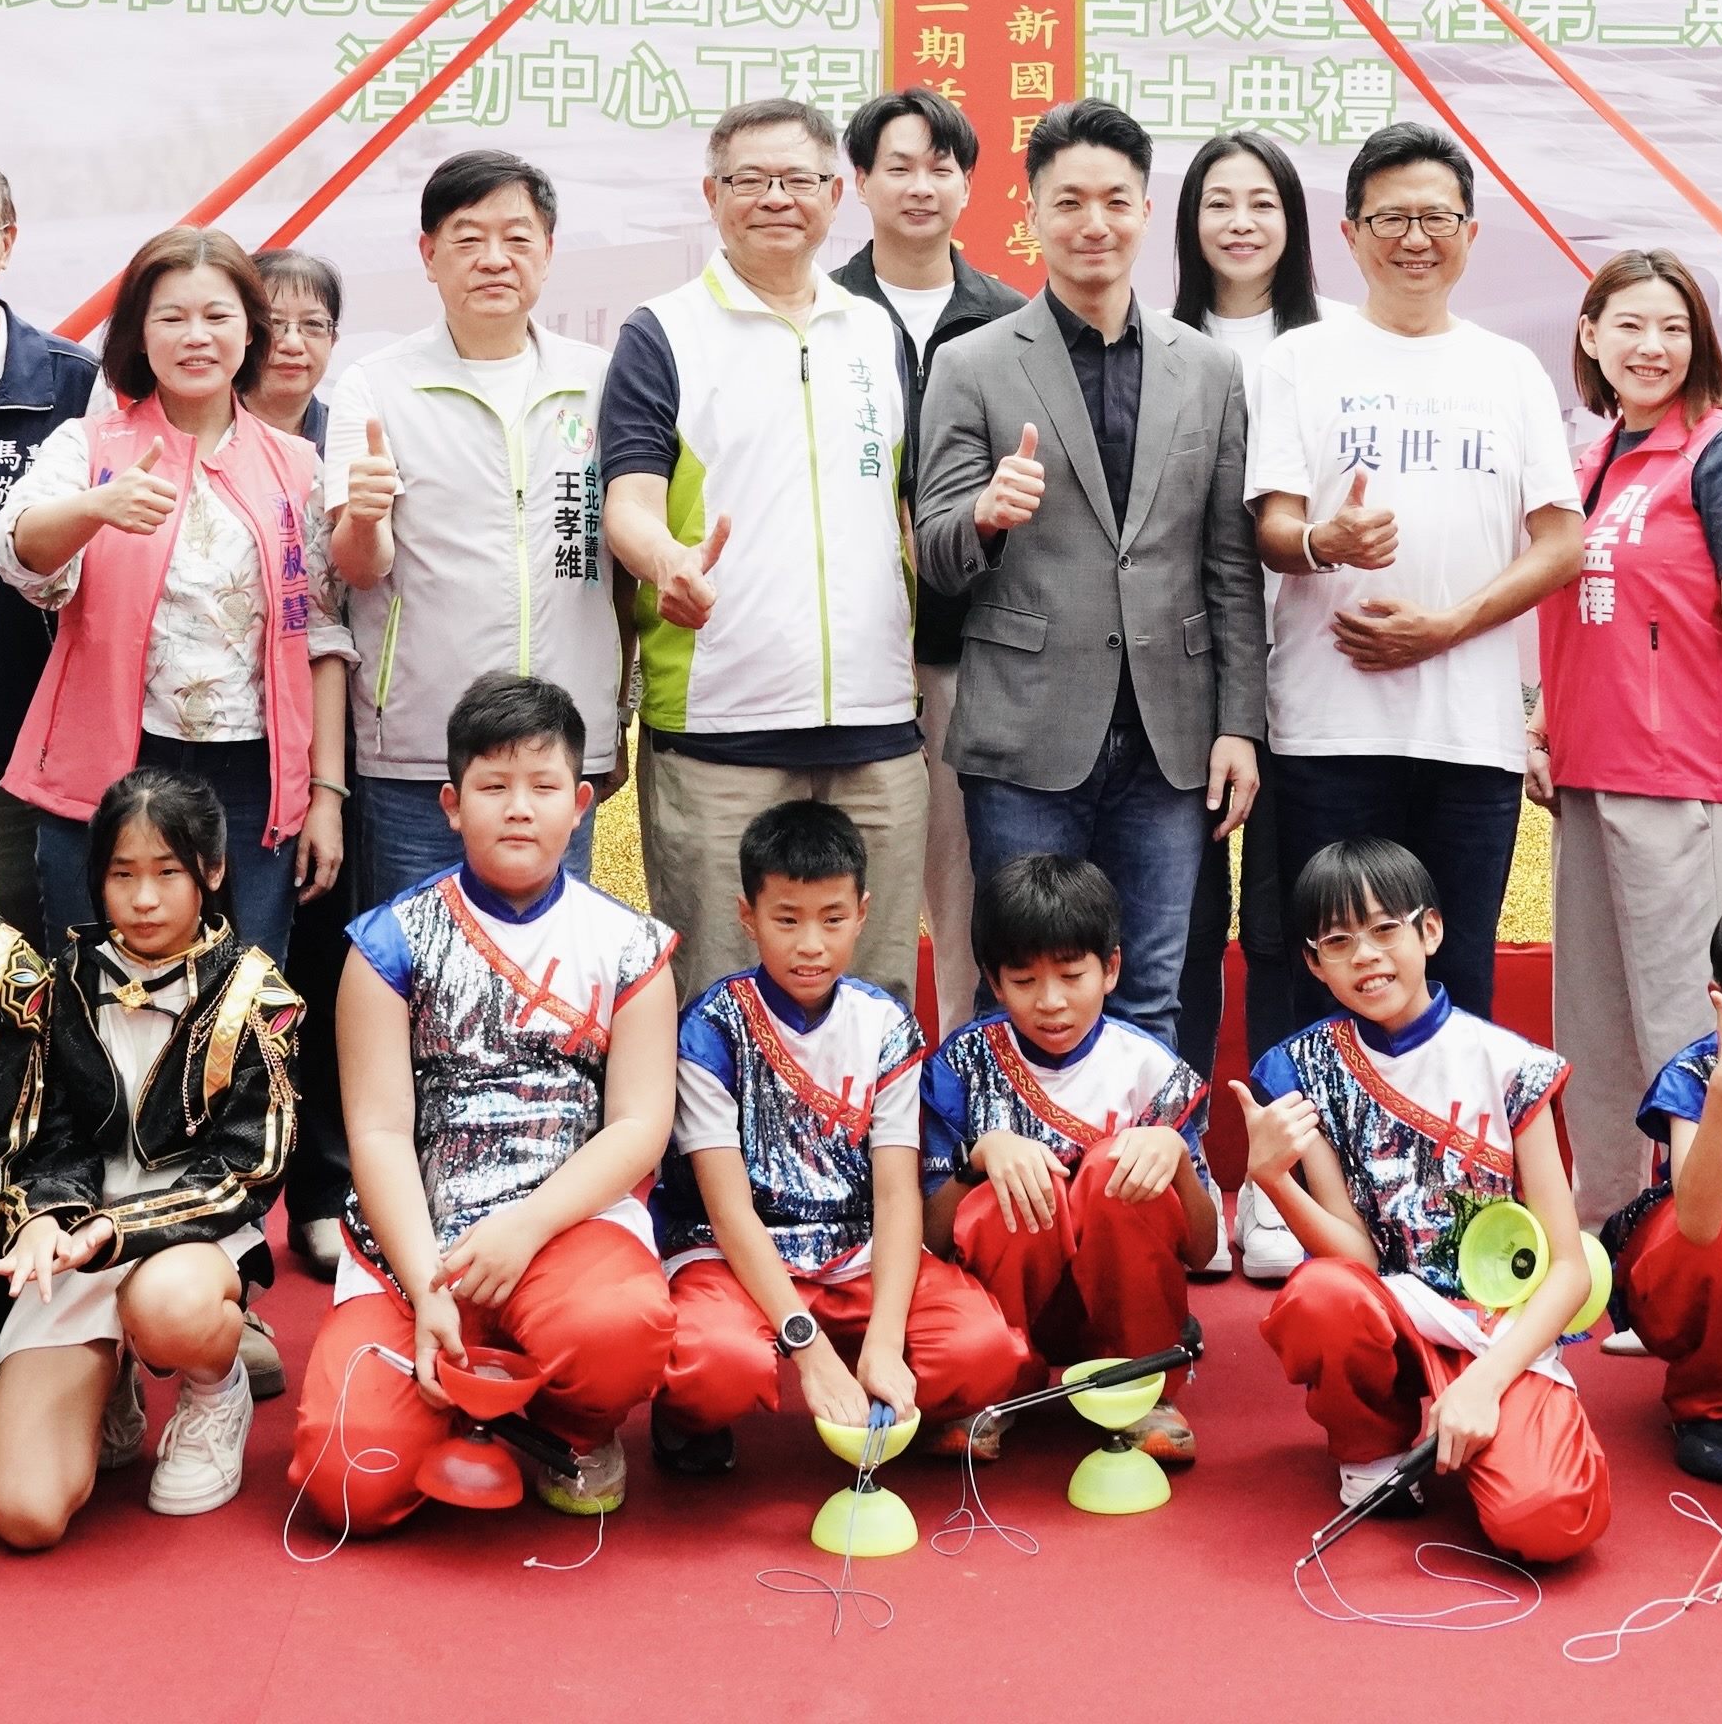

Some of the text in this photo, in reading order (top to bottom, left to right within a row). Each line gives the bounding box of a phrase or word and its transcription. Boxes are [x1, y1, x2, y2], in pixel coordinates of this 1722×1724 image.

[335, 36, 1397, 145] 活動中心工程土典禮
[1337, 425, 1497, 475] 吳世正
[554, 471, 583, 579] 王孝維
[584, 466, 600, 581] 台北市議員
